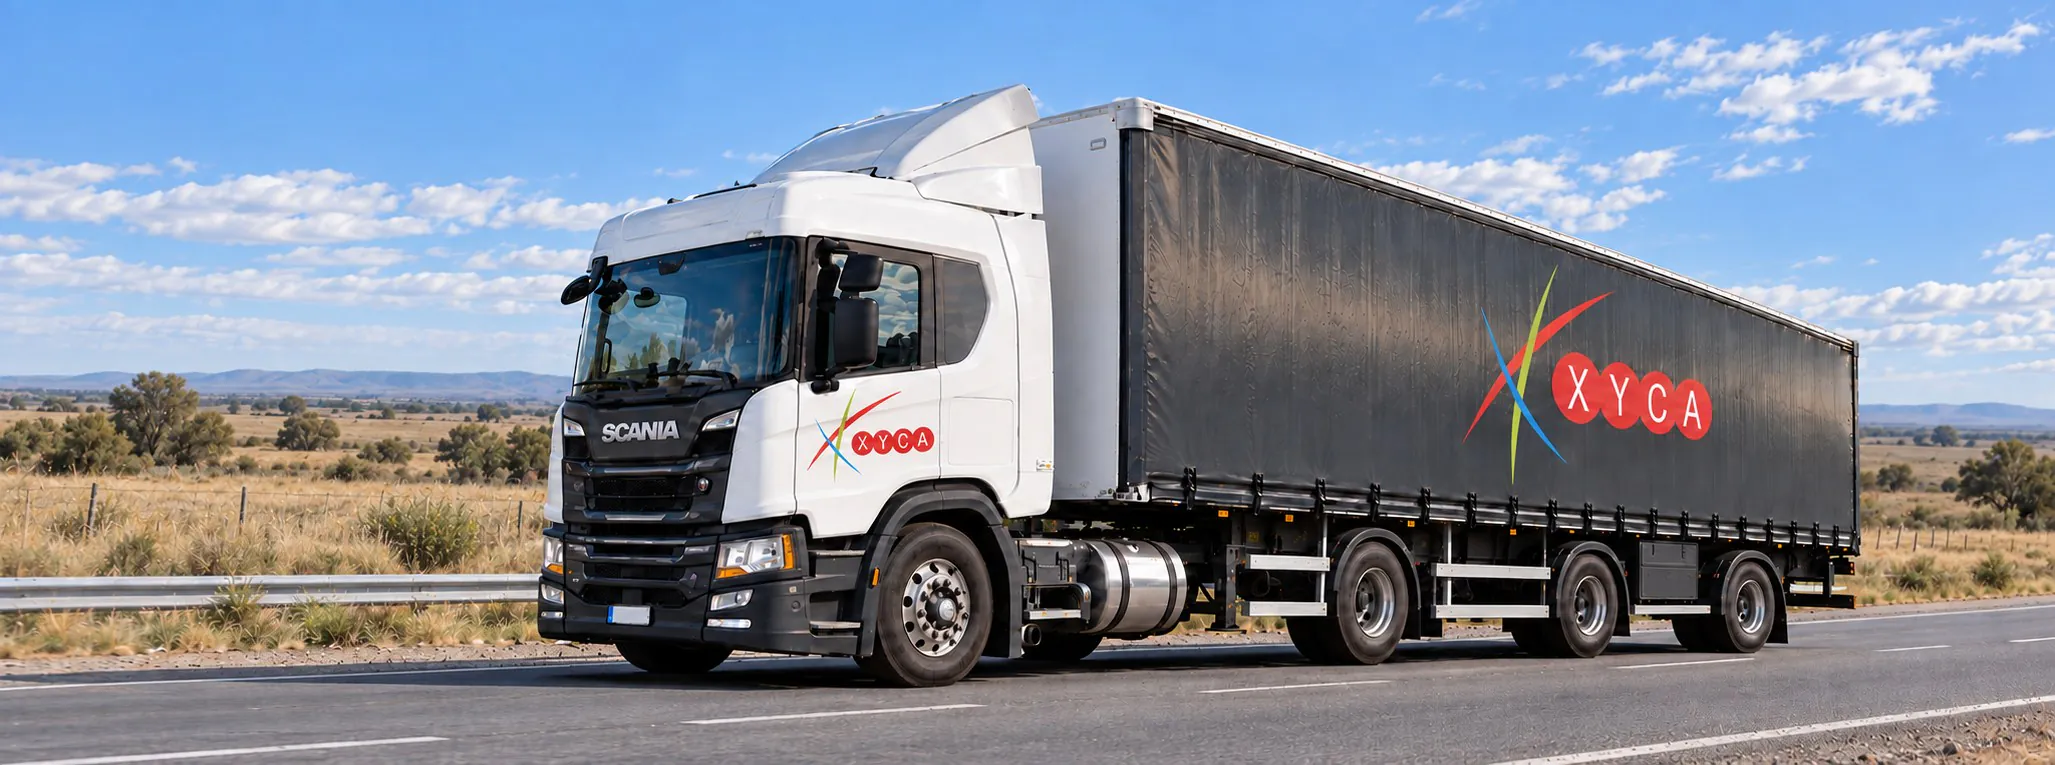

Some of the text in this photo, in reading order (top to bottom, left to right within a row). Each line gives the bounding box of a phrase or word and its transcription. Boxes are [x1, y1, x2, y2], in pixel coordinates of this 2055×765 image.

[1567, 364, 1702, 429] XYCA
[601, 420, 680, 443] SCANIA
[857, 431, 929, 451] XYCA
